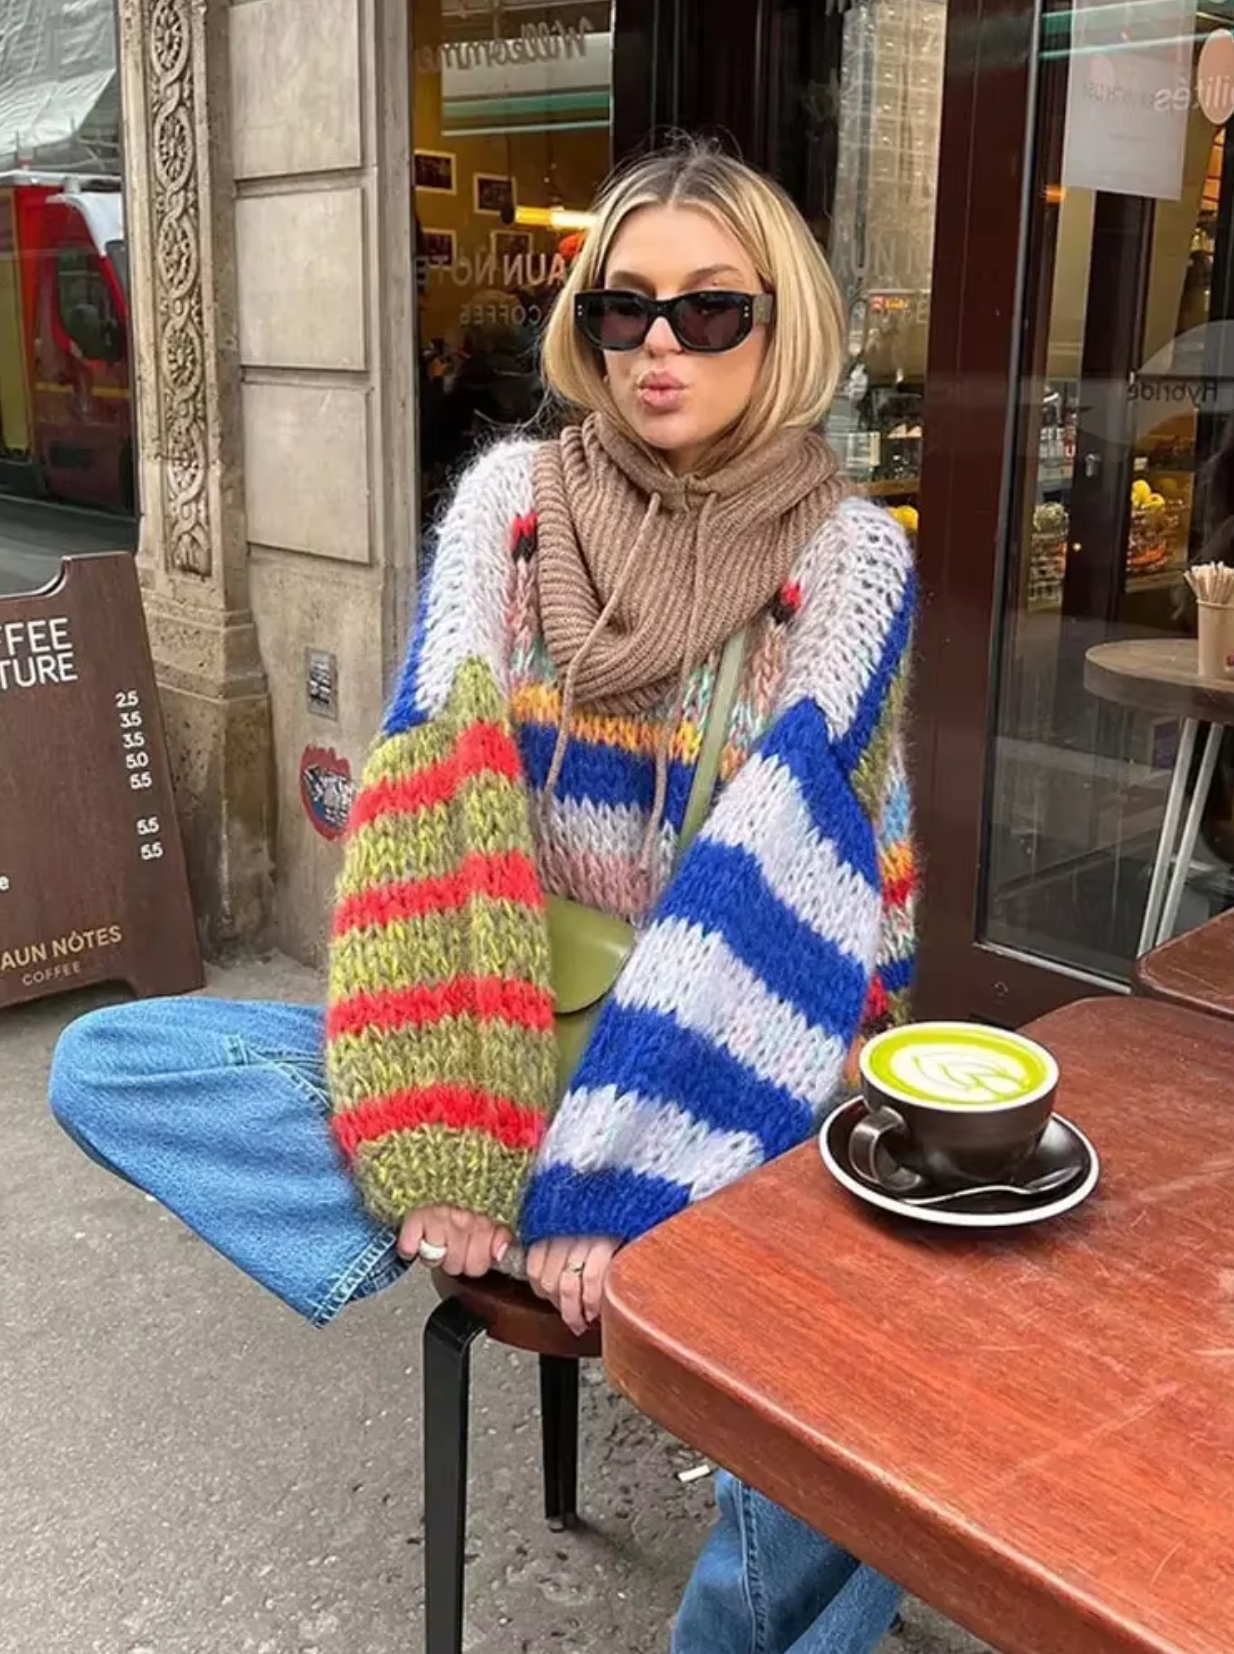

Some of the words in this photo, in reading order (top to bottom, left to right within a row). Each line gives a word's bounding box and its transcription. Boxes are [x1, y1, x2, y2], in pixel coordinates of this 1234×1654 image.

[0, 618, 72, 656] FEE
[0, 652, 78, 690] TURE
[1, 942, 47, 970] AUN
[22, 961, 82, 986] COFFEE
